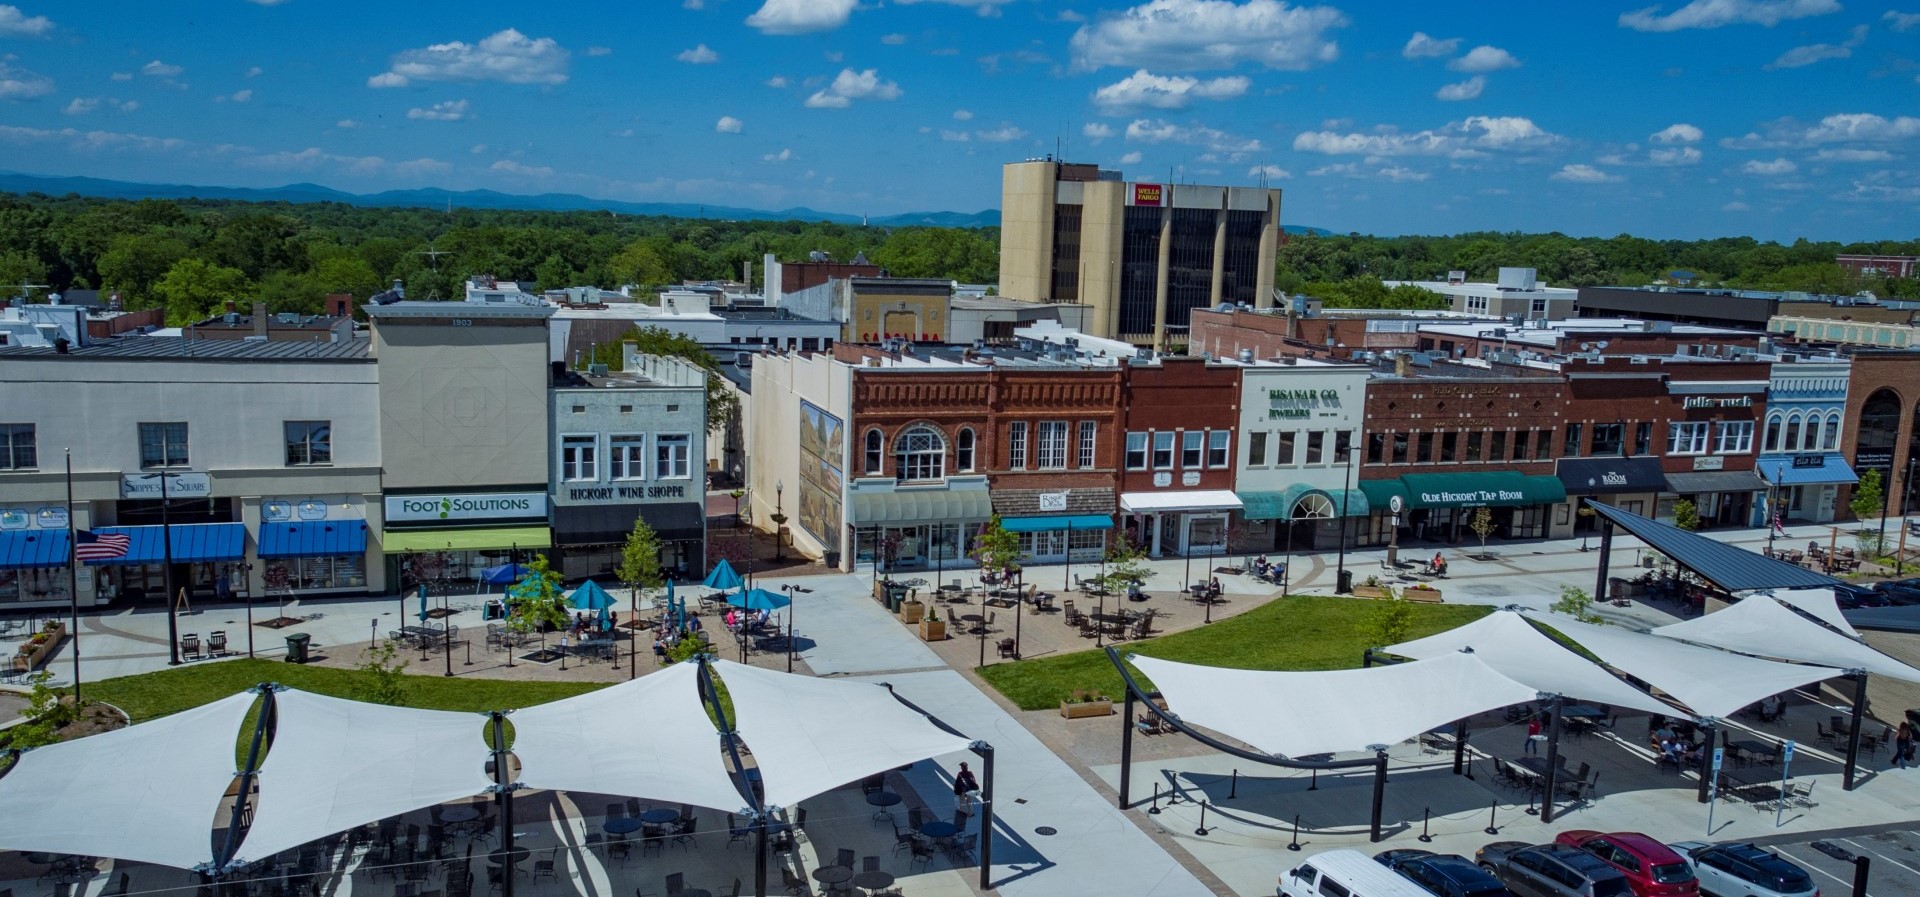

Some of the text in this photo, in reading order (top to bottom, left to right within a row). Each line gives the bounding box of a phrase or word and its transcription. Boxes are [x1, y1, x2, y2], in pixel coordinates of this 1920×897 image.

[1269, 389, 1340, 400] BISANAR CO.
[1720, 395, 1753, 407] rush
[1268, 408, 1311, 417] JEWELERS
[176, 479, 207, 492] SQUARE
[570, 485, 685, 500] HICKORY WINE SHOPPE
[1421, 490, 1523, 502] OLDE HICKORY TAP ROOM
[403, 498, 530, 512] FOOT SOLUTIONS
